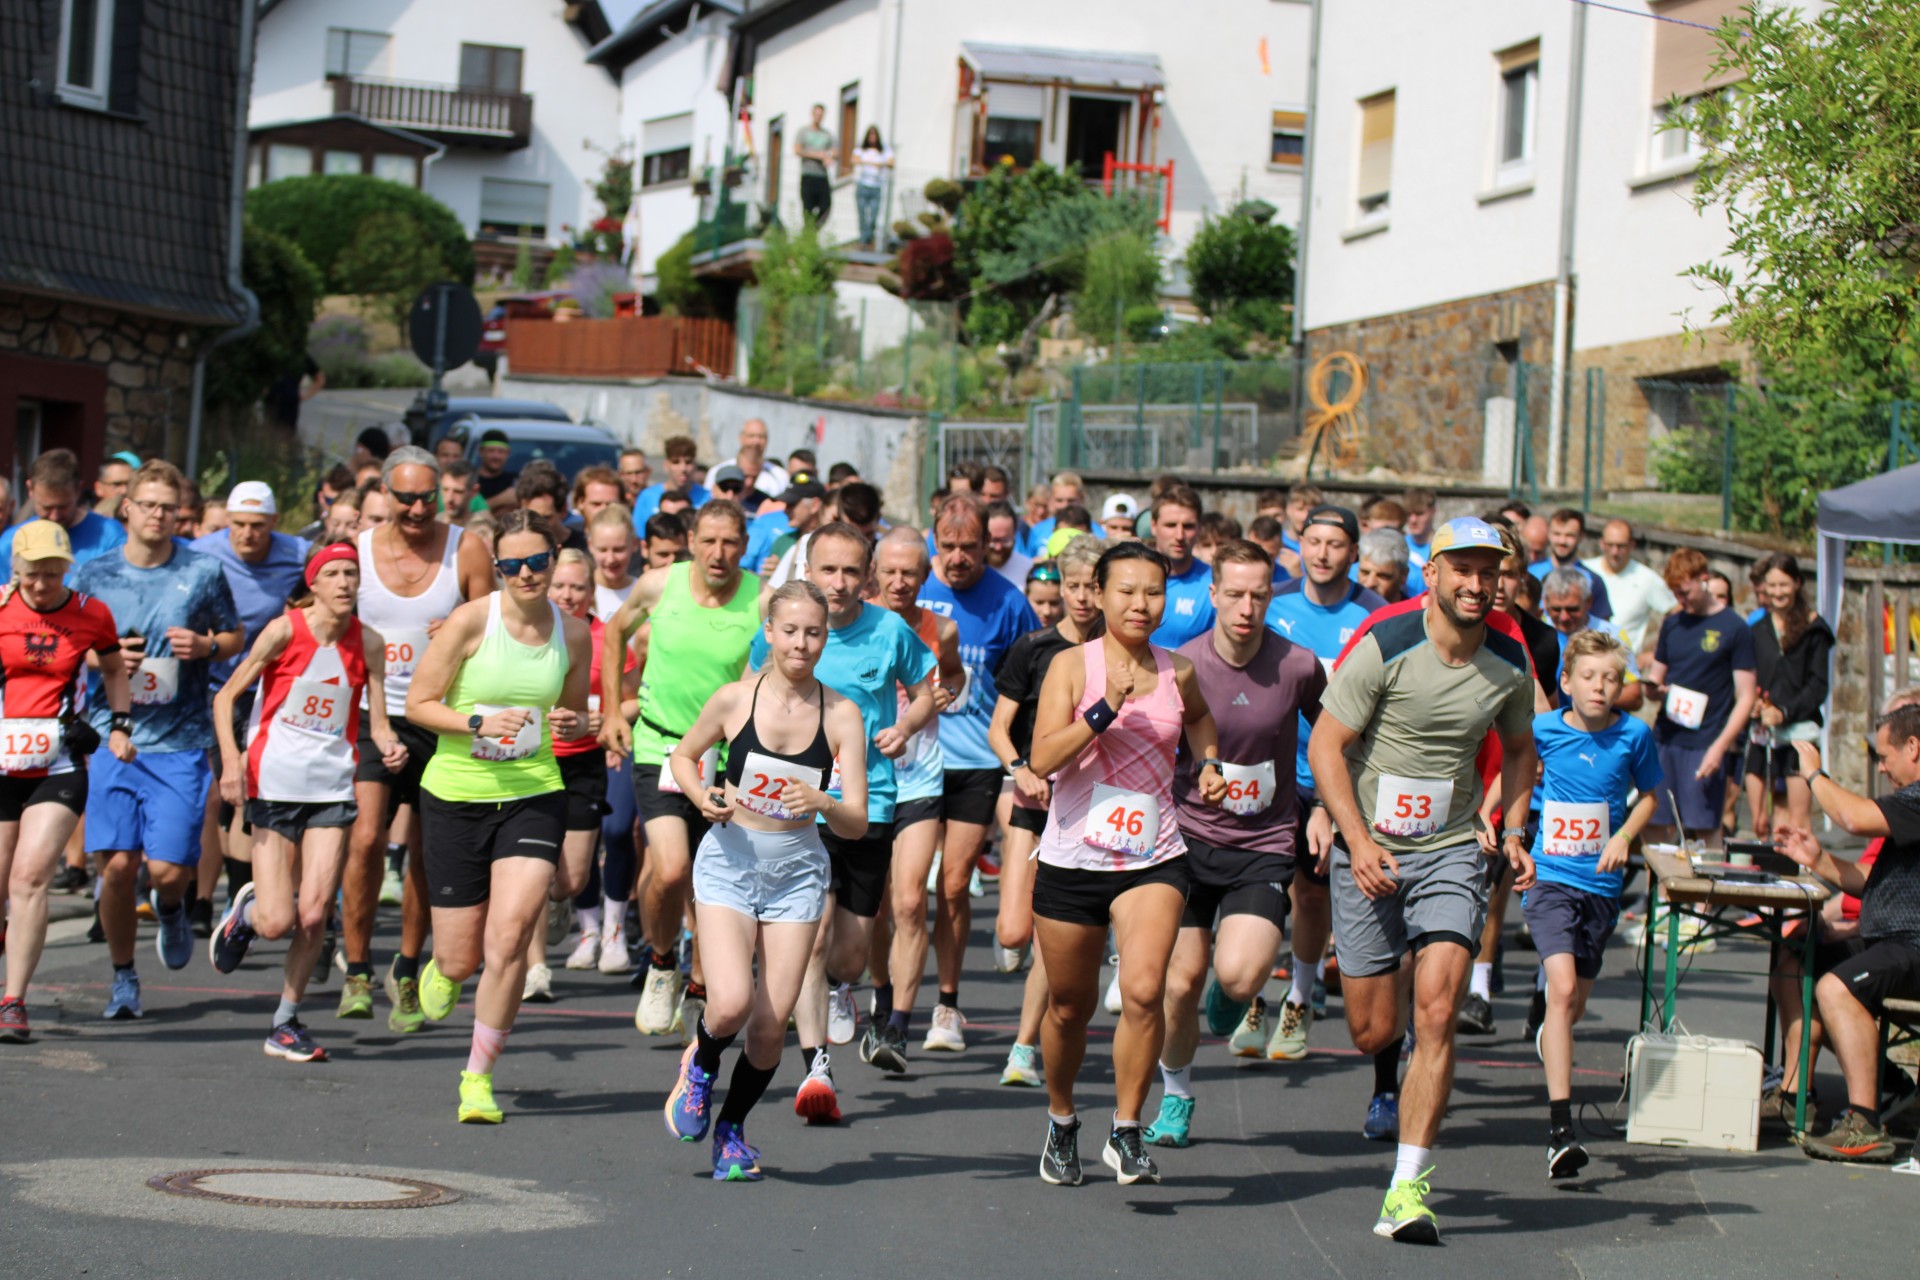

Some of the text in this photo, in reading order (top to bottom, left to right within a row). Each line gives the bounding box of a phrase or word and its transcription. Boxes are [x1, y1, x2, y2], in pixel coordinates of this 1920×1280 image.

[385, 643, 414, 663] 60
[143, 671, 158, 692] 3
[303, 695, 335, 719] 85
[1674, 697, 1694, 716] 12
[5, 733, 51, 755] 129
[1227, 779, 1260, 801] 64
[1394, 794, 1432, 819] 53
[1106, 805, 1145, 836] 46
[1552, 817, 1602, 841] 252
